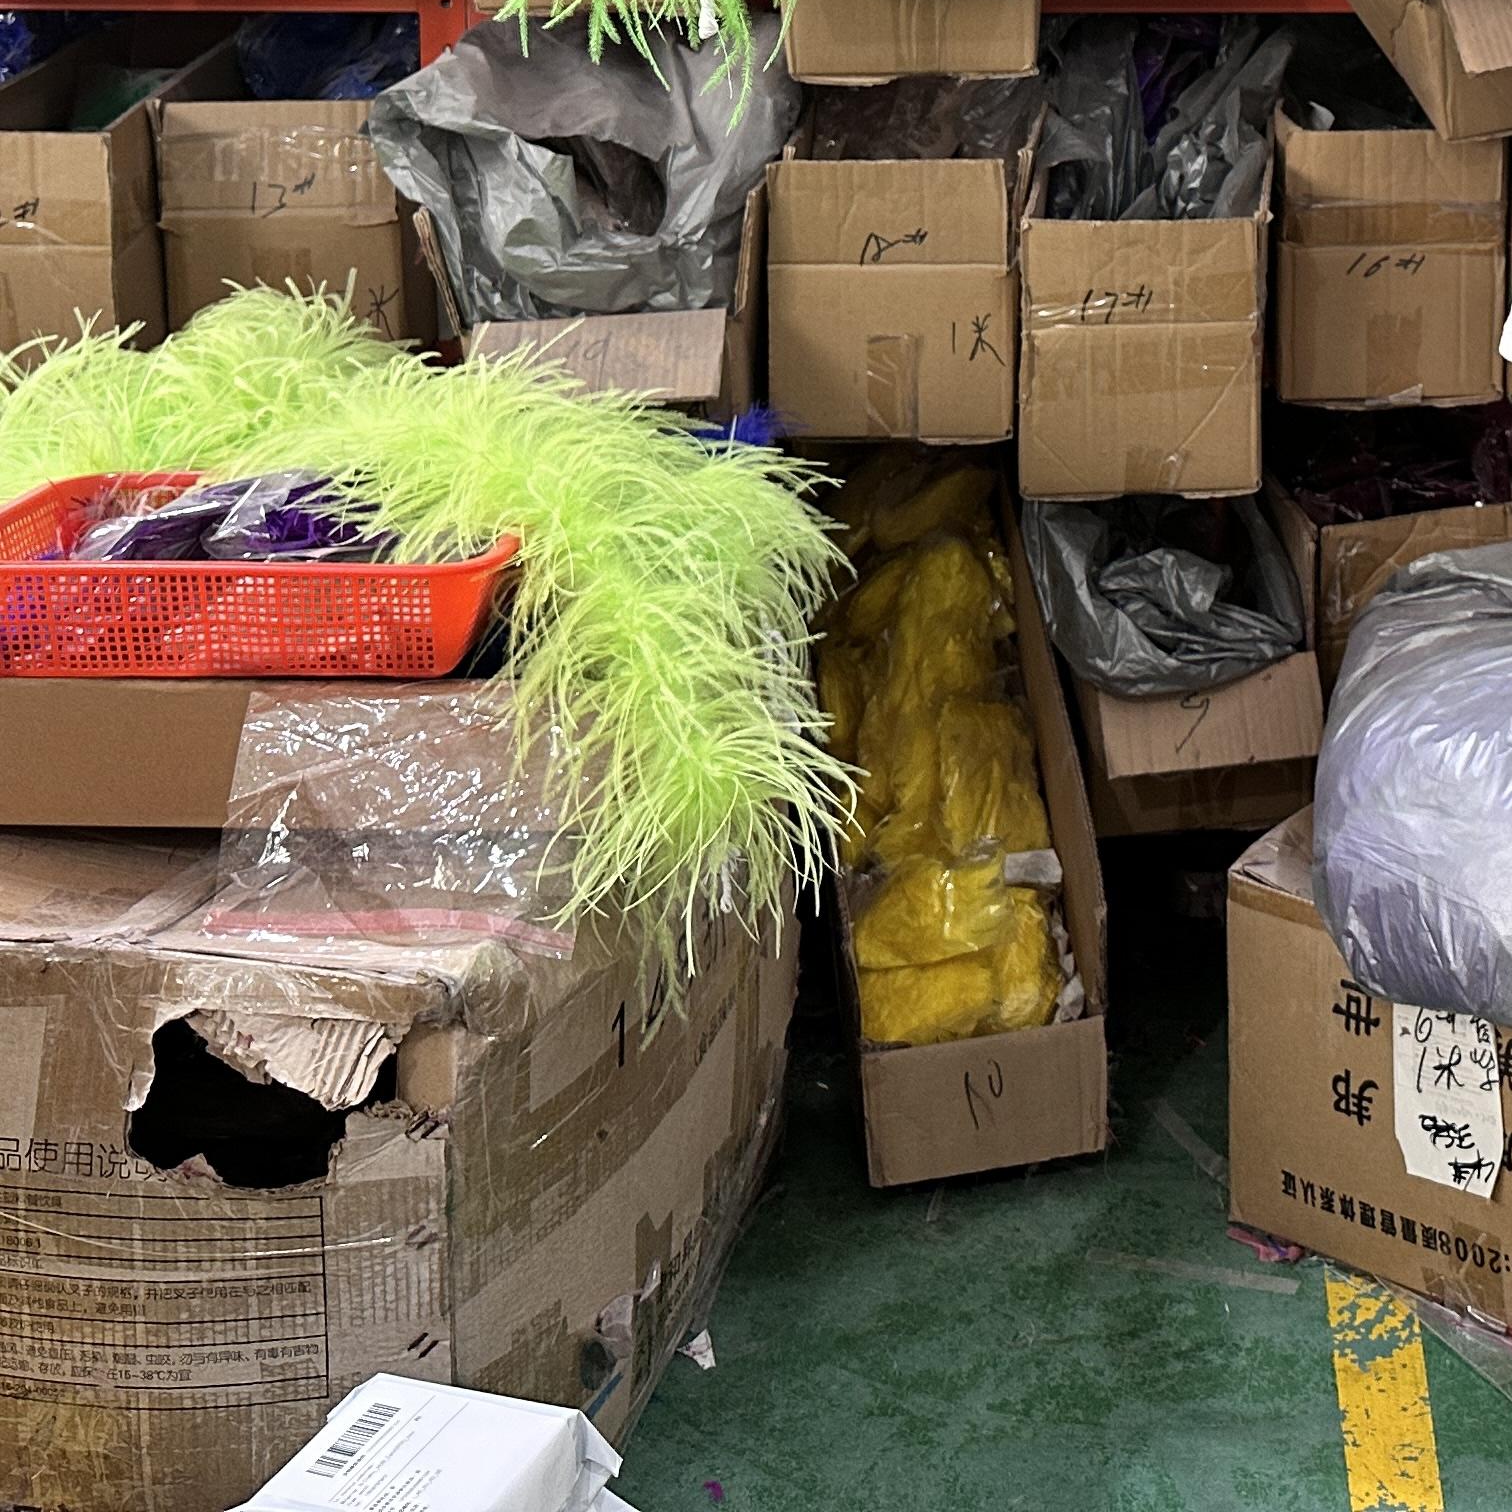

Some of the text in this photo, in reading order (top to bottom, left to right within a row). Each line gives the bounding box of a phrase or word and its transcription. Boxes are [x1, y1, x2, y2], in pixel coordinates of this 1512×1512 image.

[251, 172, 316, 219] 13#
[1346, 252, 1427, 278] 16#
[1081, 284, 1153, 324] 17#
